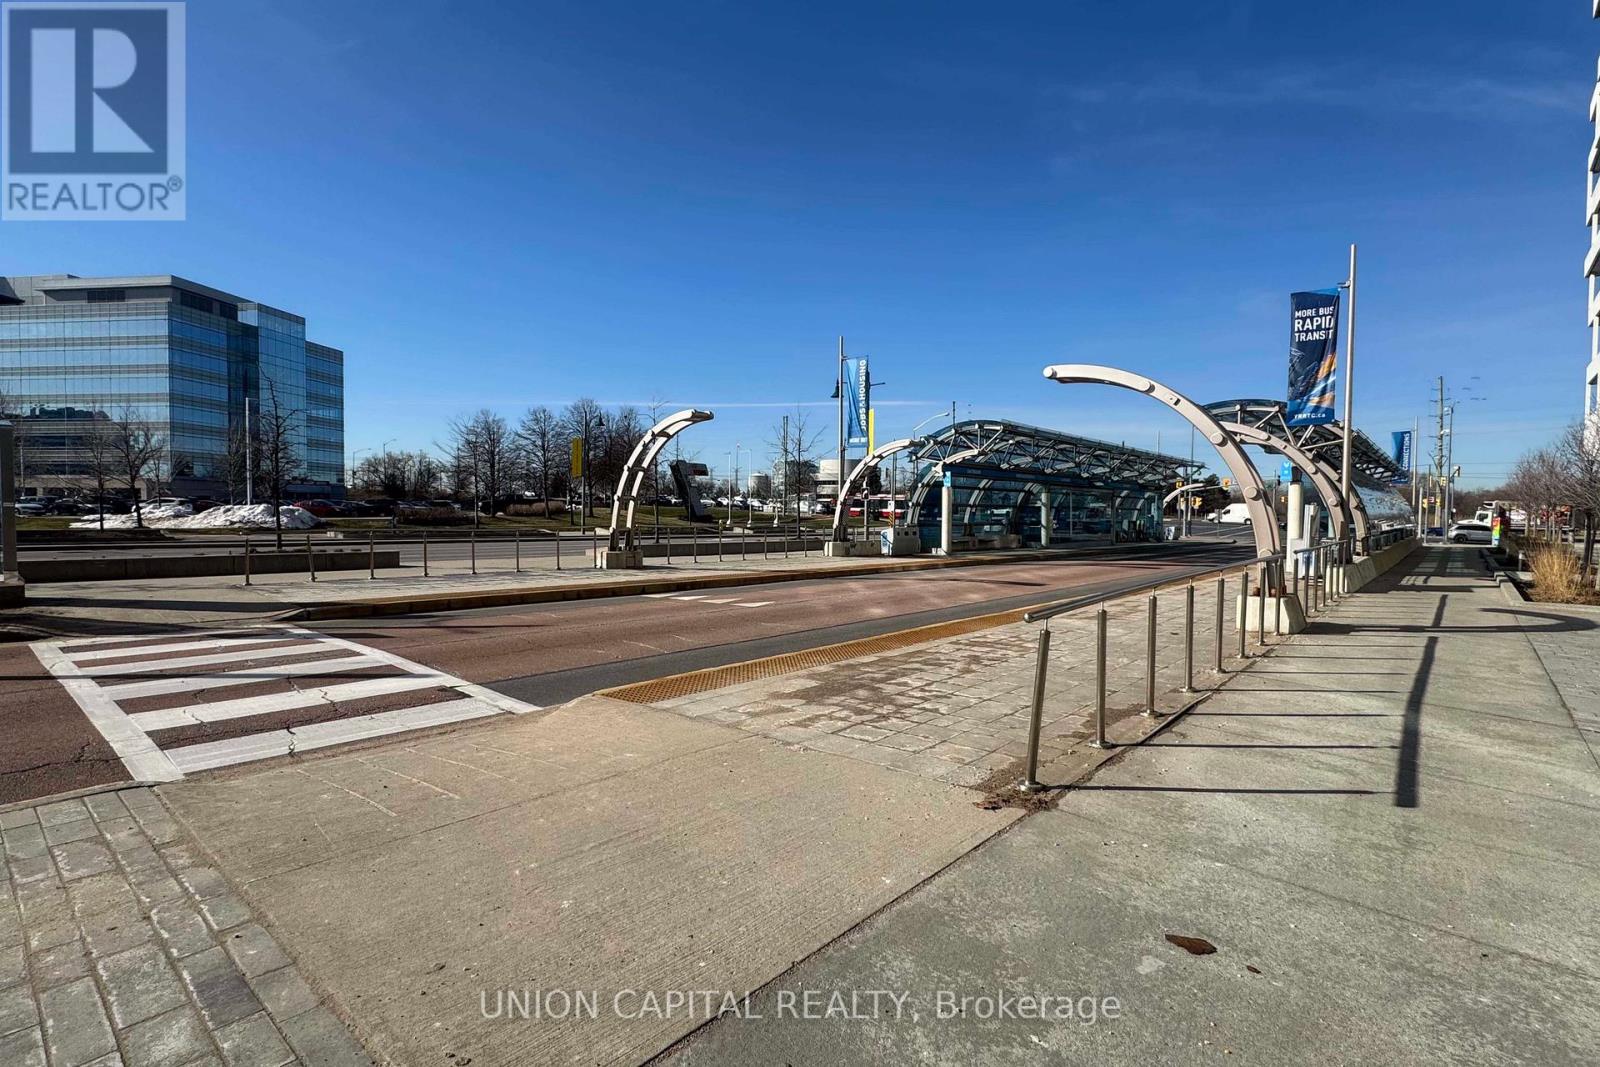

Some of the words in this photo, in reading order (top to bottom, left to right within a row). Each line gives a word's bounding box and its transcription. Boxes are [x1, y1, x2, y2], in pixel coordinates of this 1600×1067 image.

[1294, 308, 1317, 318] MORE
[1319, 306, 1334, 316] BUS
[1294, 316, 1334, 332] RAPID
[1294, 330, 1334, 342] TRANSIT
